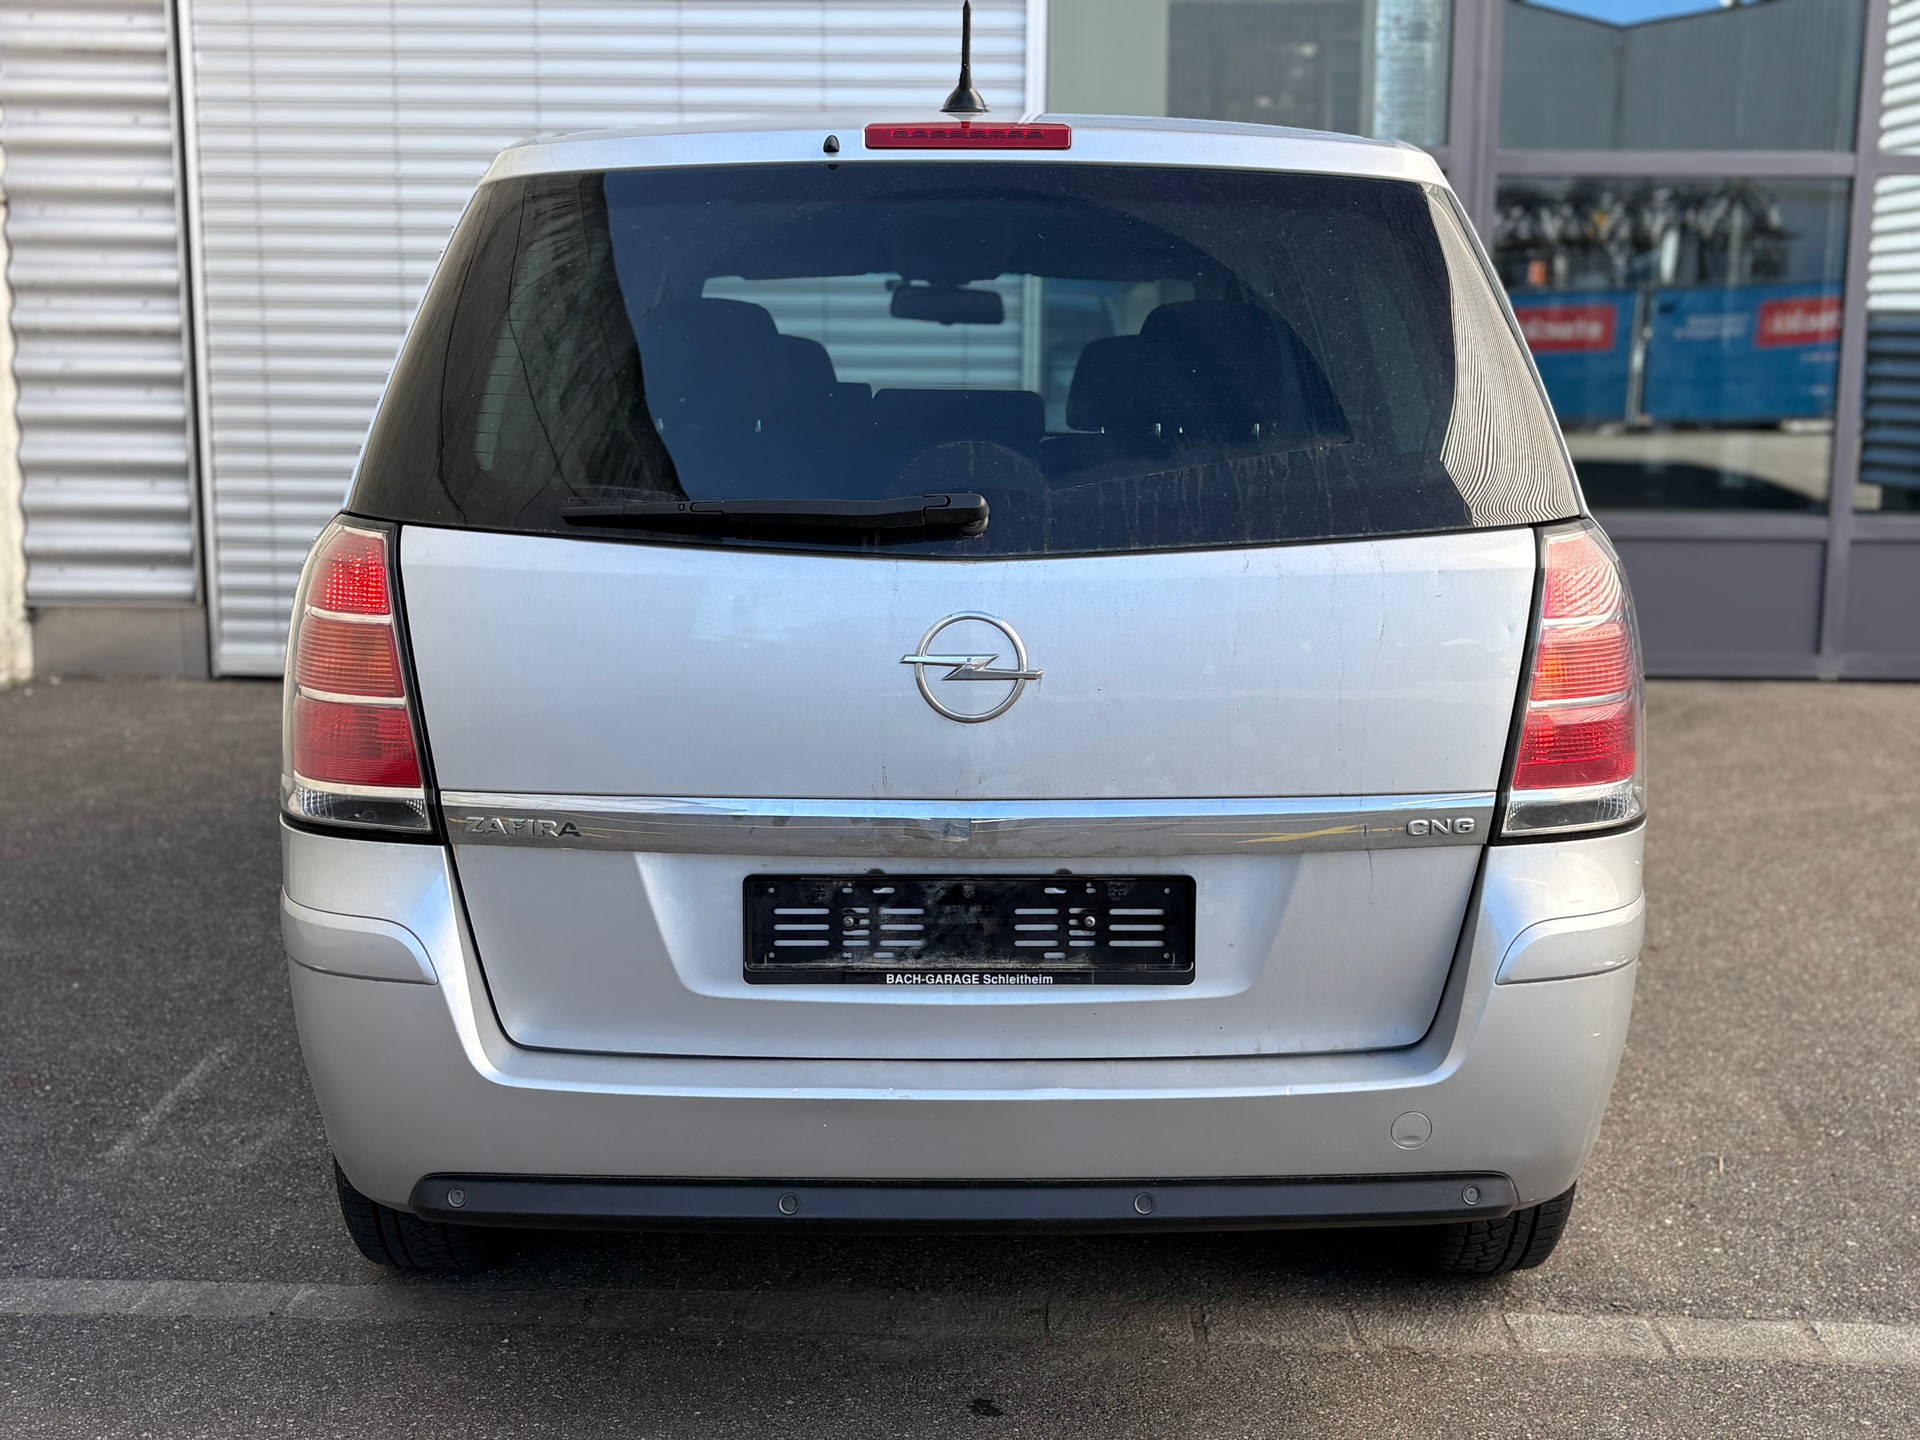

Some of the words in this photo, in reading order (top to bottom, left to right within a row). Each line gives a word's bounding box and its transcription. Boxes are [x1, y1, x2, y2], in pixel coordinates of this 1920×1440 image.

[464, 816, 581, 837] ZAFIRA
[1406, 817, 1475, 836] CNG
[886, 973, 980, 985] BACH-GARAGE
[982, 973, 1054, 985] Schleitheim
